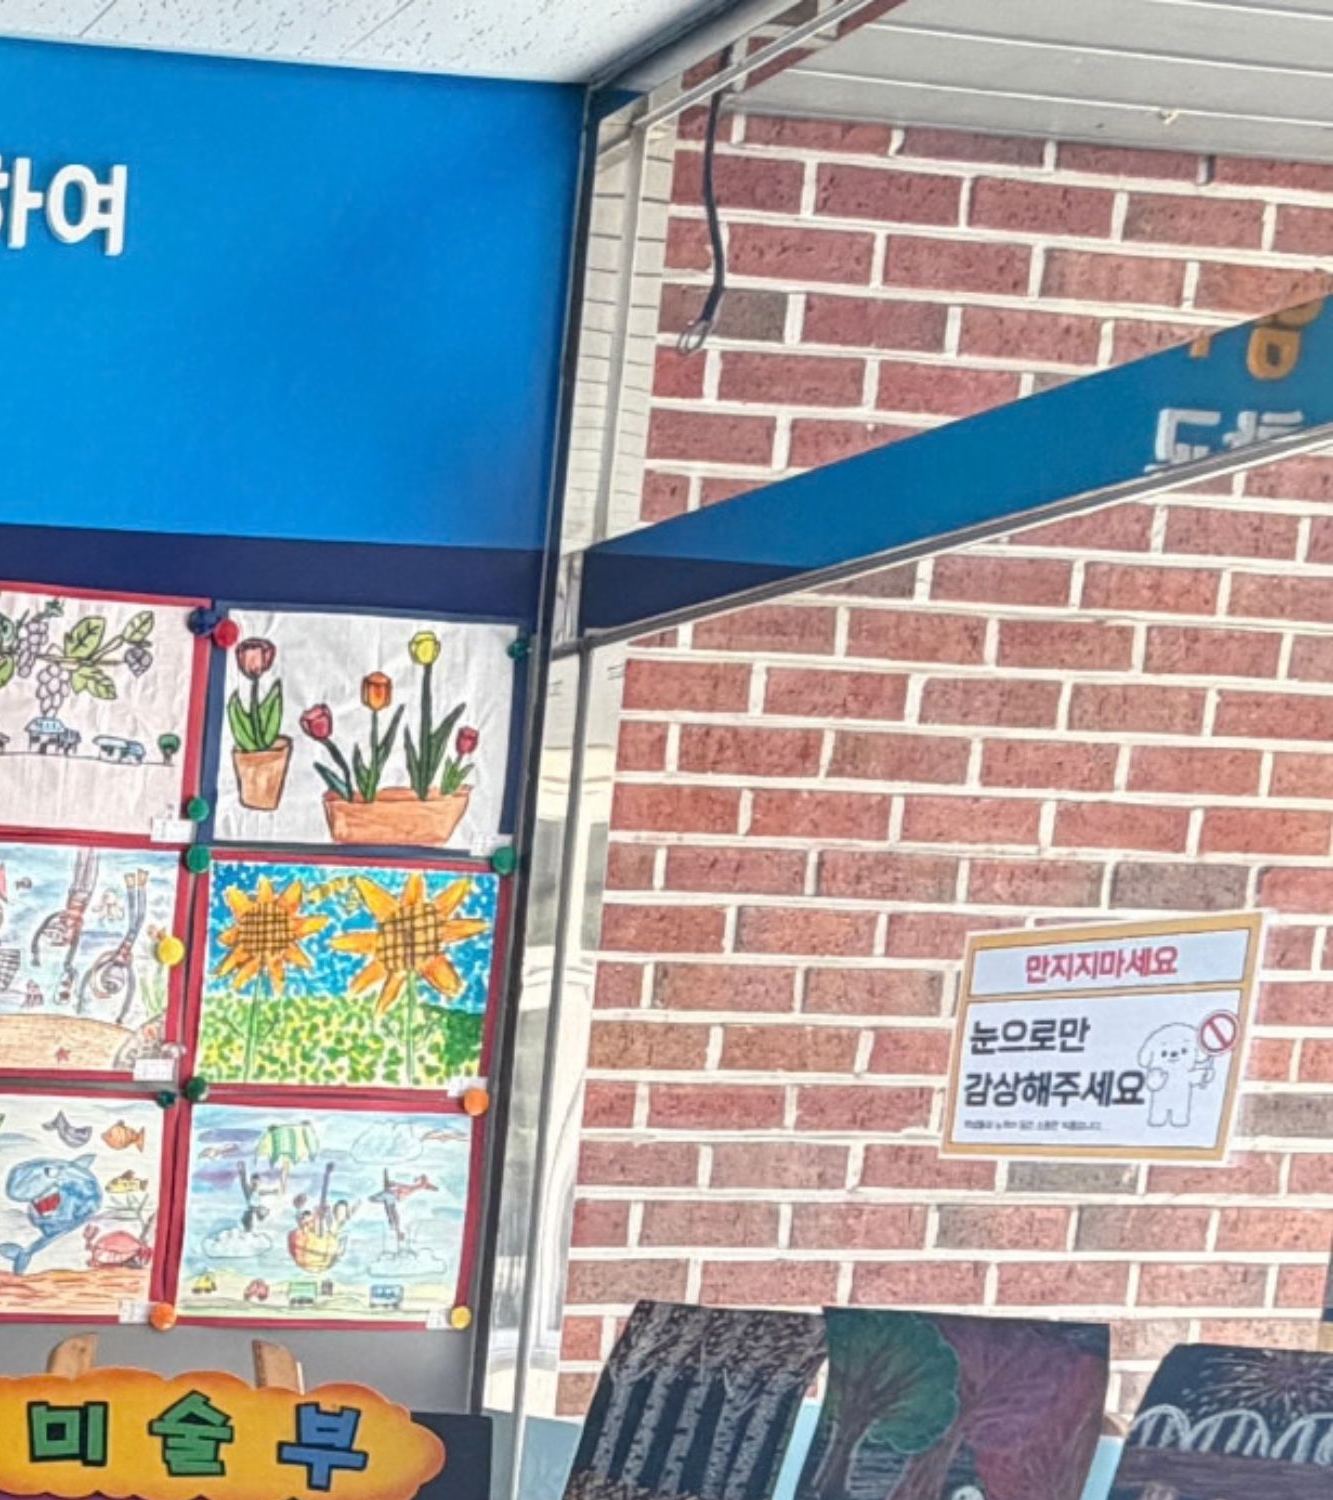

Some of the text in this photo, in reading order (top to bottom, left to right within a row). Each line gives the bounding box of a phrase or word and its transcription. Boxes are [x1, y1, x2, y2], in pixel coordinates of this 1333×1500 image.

[1026, 946, 1179, 984] 만지지마세요
[969, 1017, 1091, 1056] 눈으로만
[964, 1070, 1146, 1108] 감상해주세요
[27, 1390, 368, 1491] 미술부
